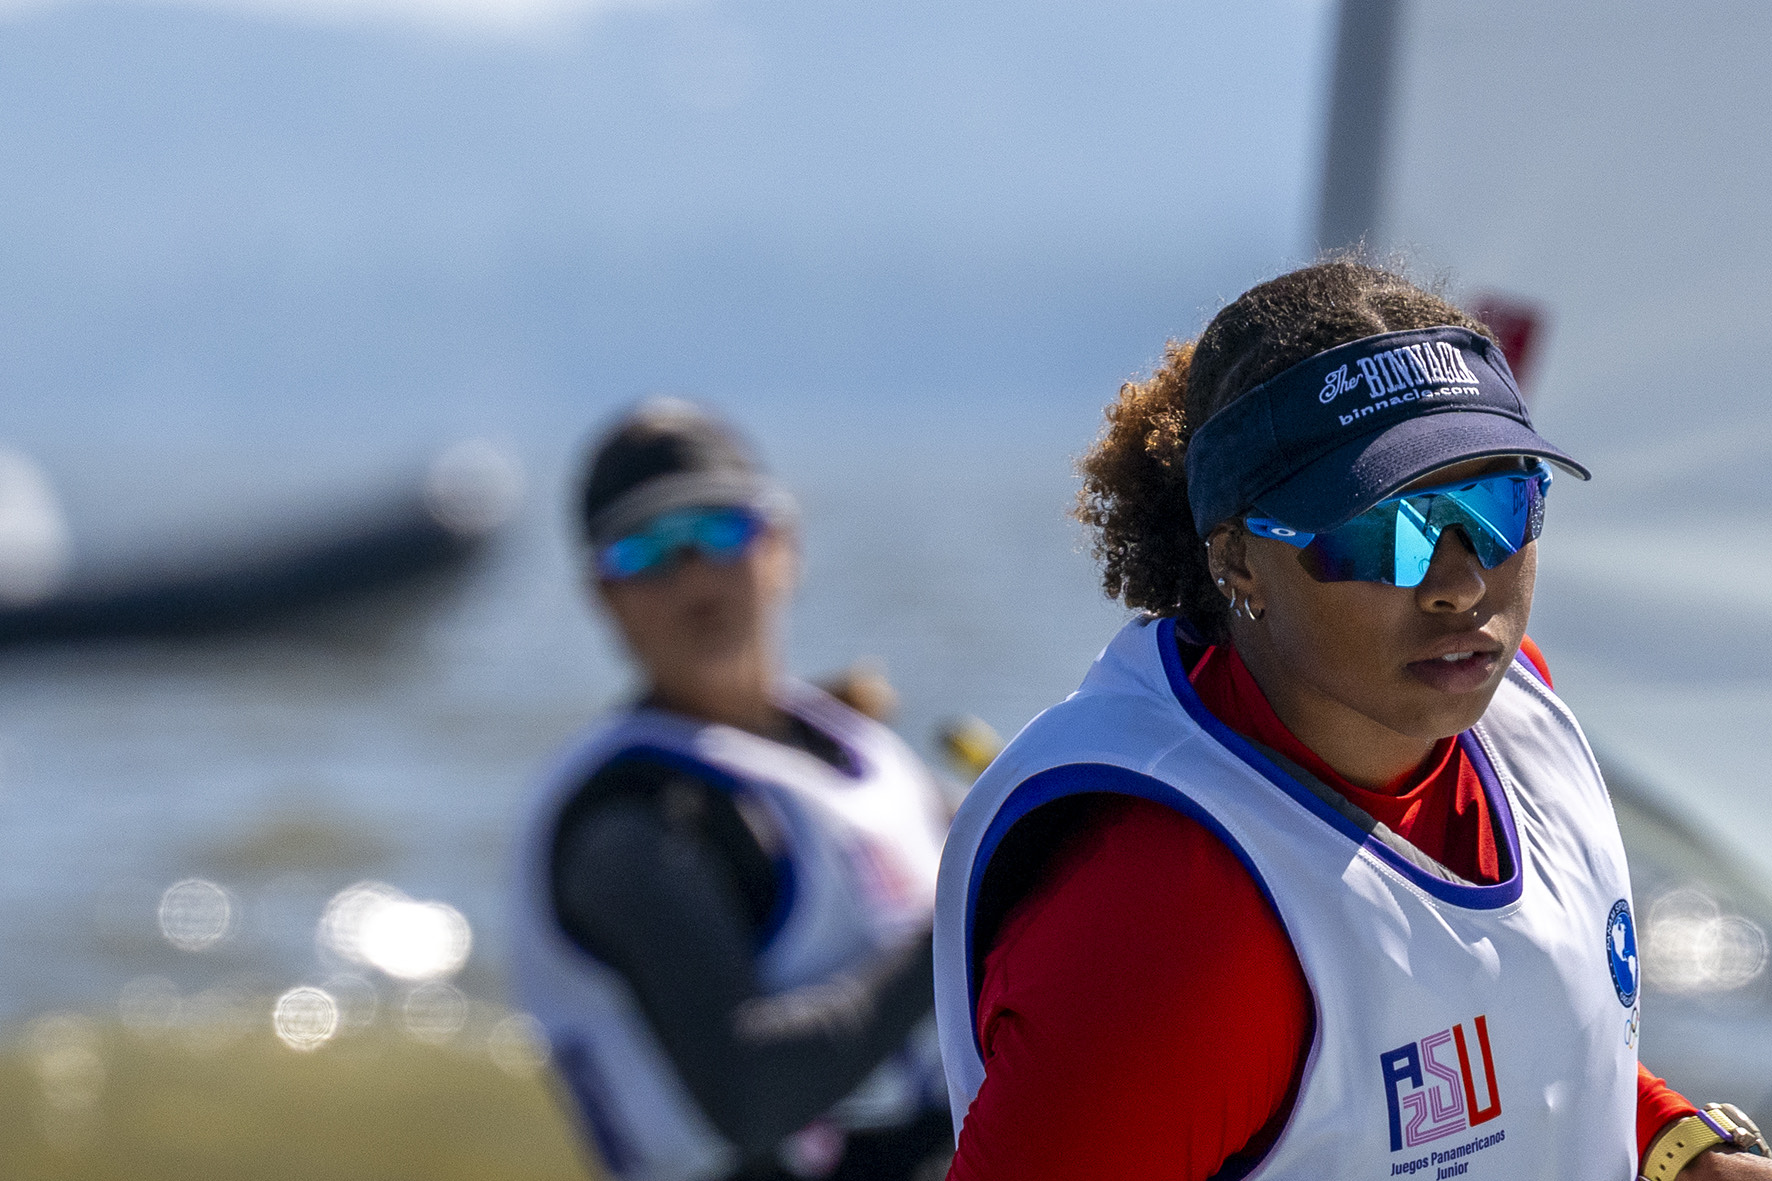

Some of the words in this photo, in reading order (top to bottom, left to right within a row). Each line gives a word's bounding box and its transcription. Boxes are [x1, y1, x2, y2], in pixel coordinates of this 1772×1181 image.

[1318, 364, 1363, 404] The
[1338, 386, 1480, 426] binnacle.com
[1390, 1155, 1429, 1177] Juegos
[1431, 1129, 1506, 1167] Panamericanos
[1436, 1160, 1469, 1181] Junior
